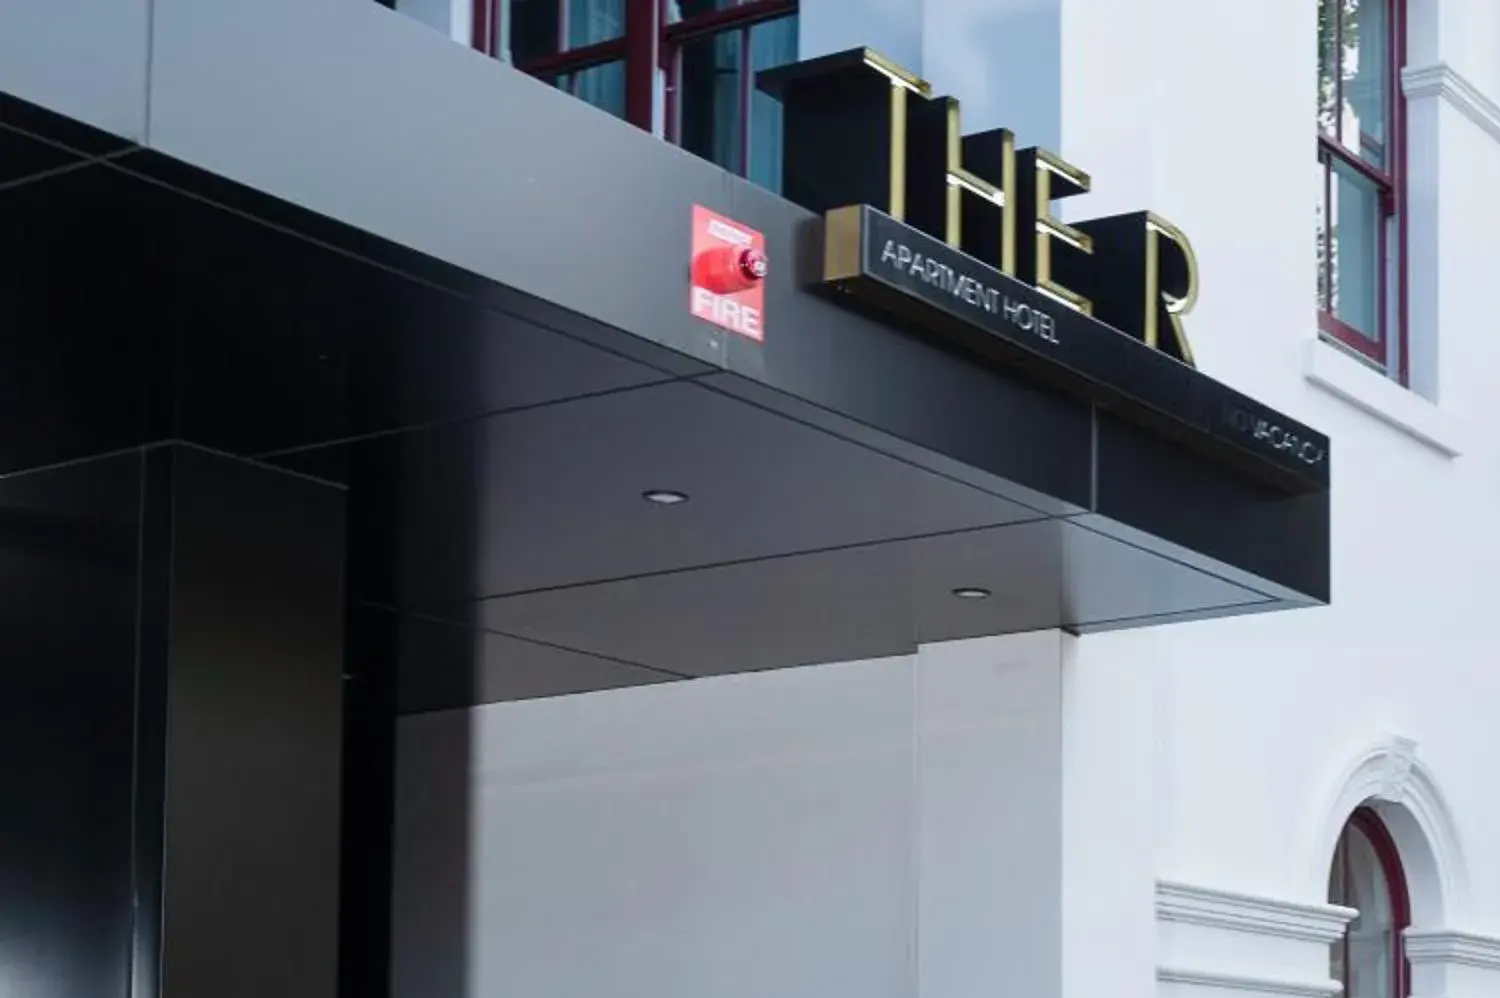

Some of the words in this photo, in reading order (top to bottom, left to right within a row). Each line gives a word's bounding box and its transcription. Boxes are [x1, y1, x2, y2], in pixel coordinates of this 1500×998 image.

[690, 286, 764, 341] FIRE
[881, 239, 1000, 314] APARTMENT
[1003, 295, 1060, 345] HOTEL
